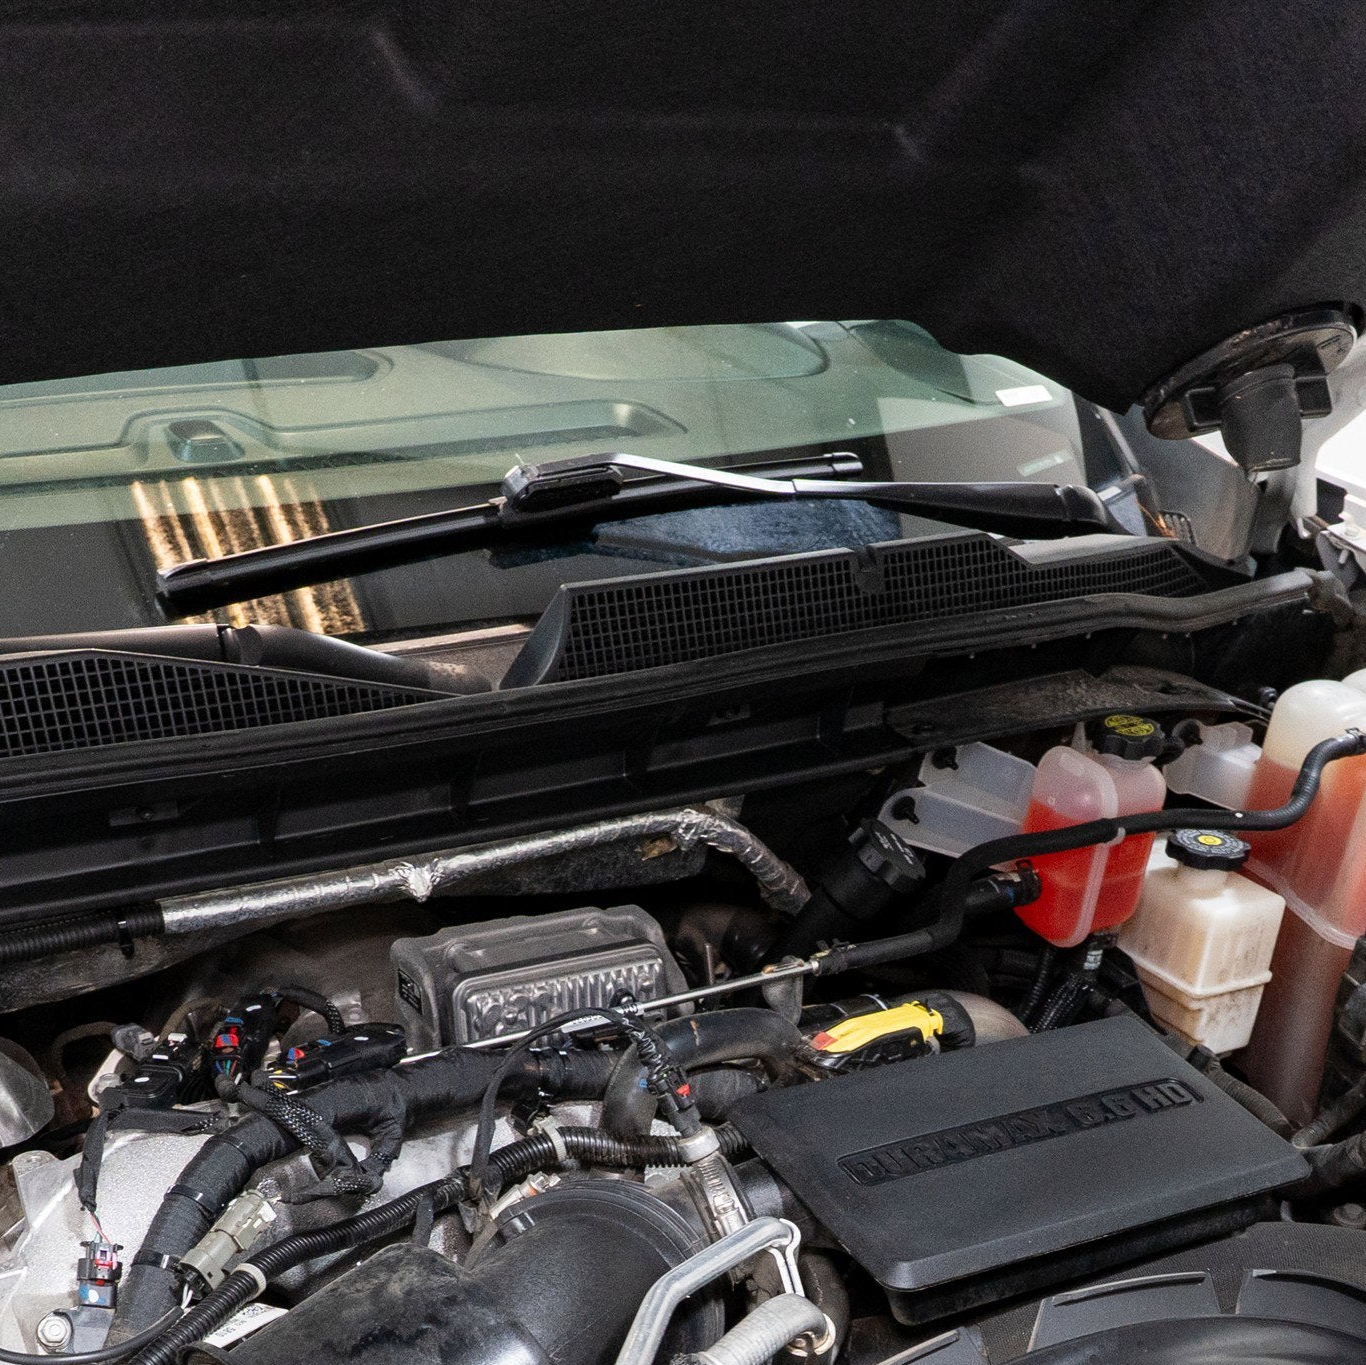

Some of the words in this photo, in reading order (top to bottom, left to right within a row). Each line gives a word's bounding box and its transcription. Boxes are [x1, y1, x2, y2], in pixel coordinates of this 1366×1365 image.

[847, 1108, 1066, 1184] DURAMAX
[1067, 1093, 1137, 1127] 6.6
[1130, 1082, 1193, 1113] HD
